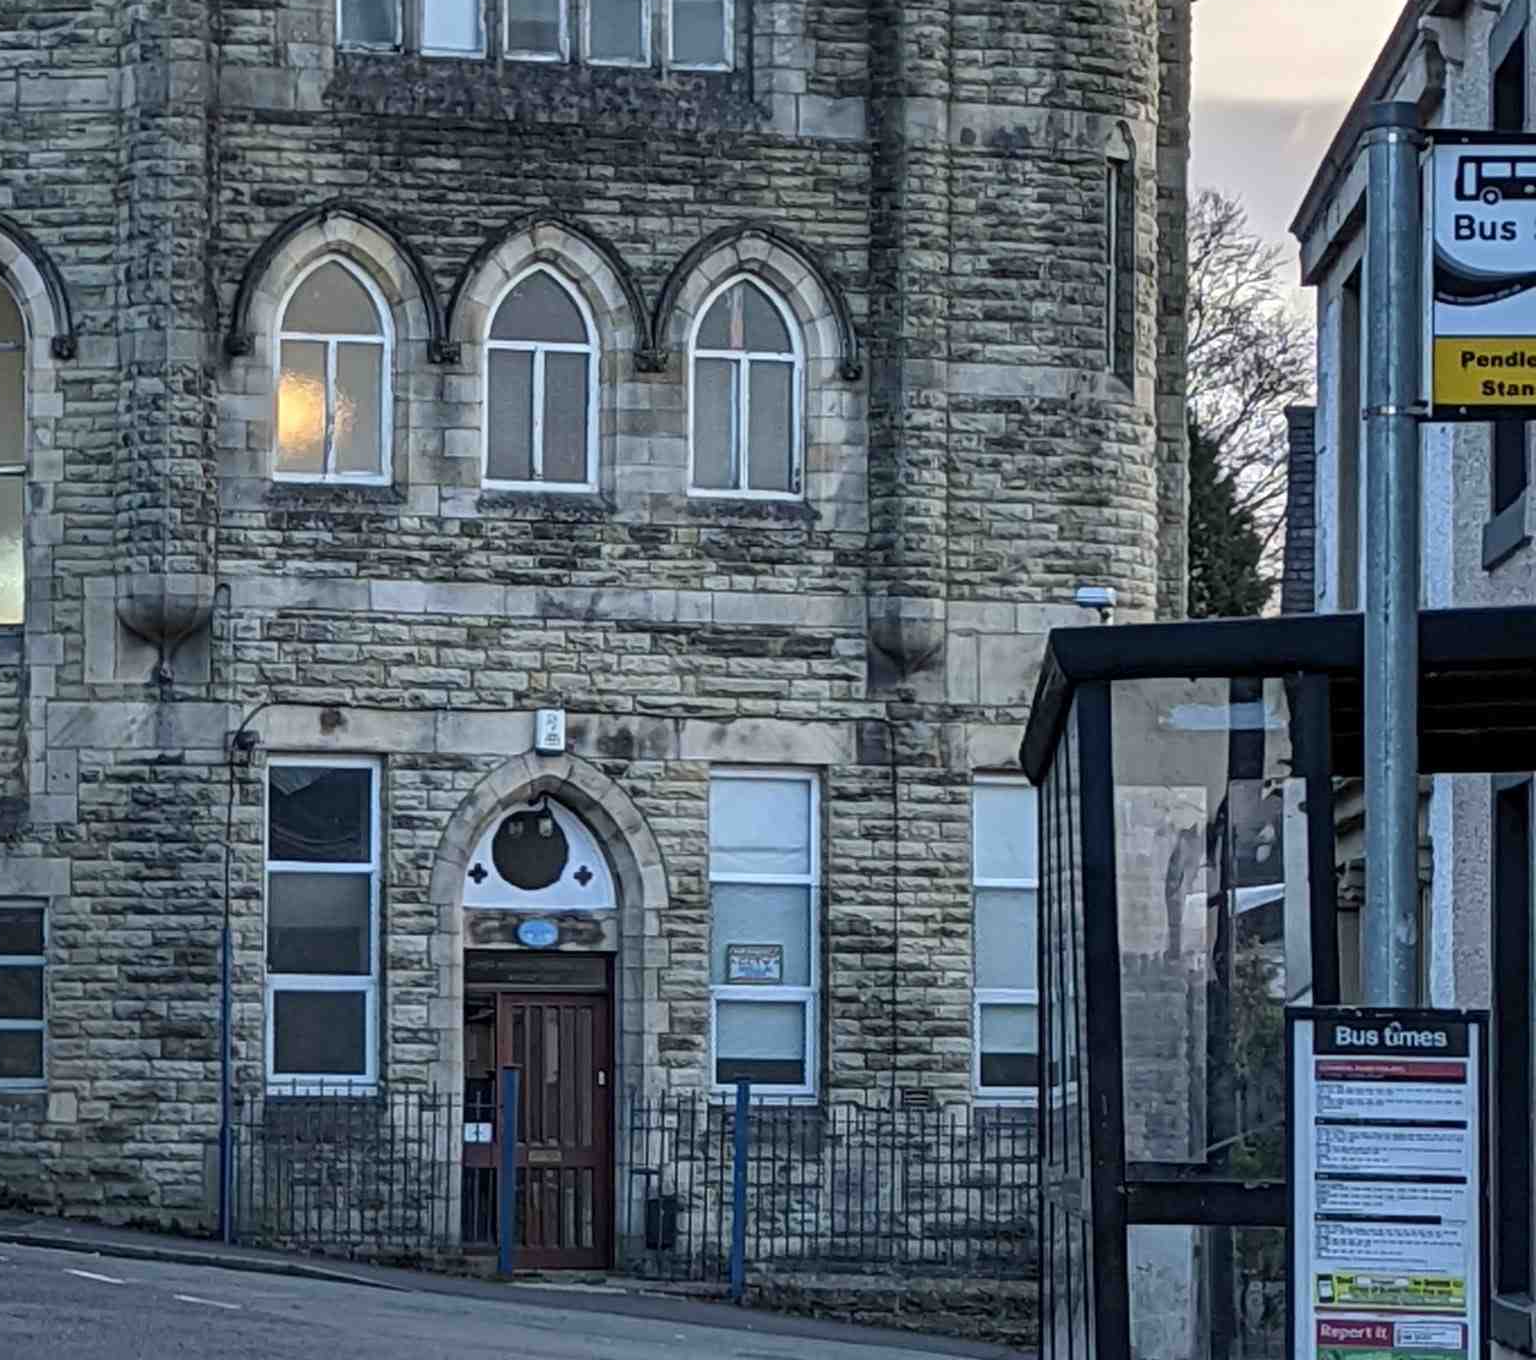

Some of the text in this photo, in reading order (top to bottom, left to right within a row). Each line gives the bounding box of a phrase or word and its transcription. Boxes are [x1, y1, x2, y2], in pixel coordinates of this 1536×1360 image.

[1455, 214, 1517, 241] Bus
[1482, 380, 1534, 397] Stan
[1335, 1022, 1448, 1048] Bus times
[1320, 1323, 1372, 1341] Report
